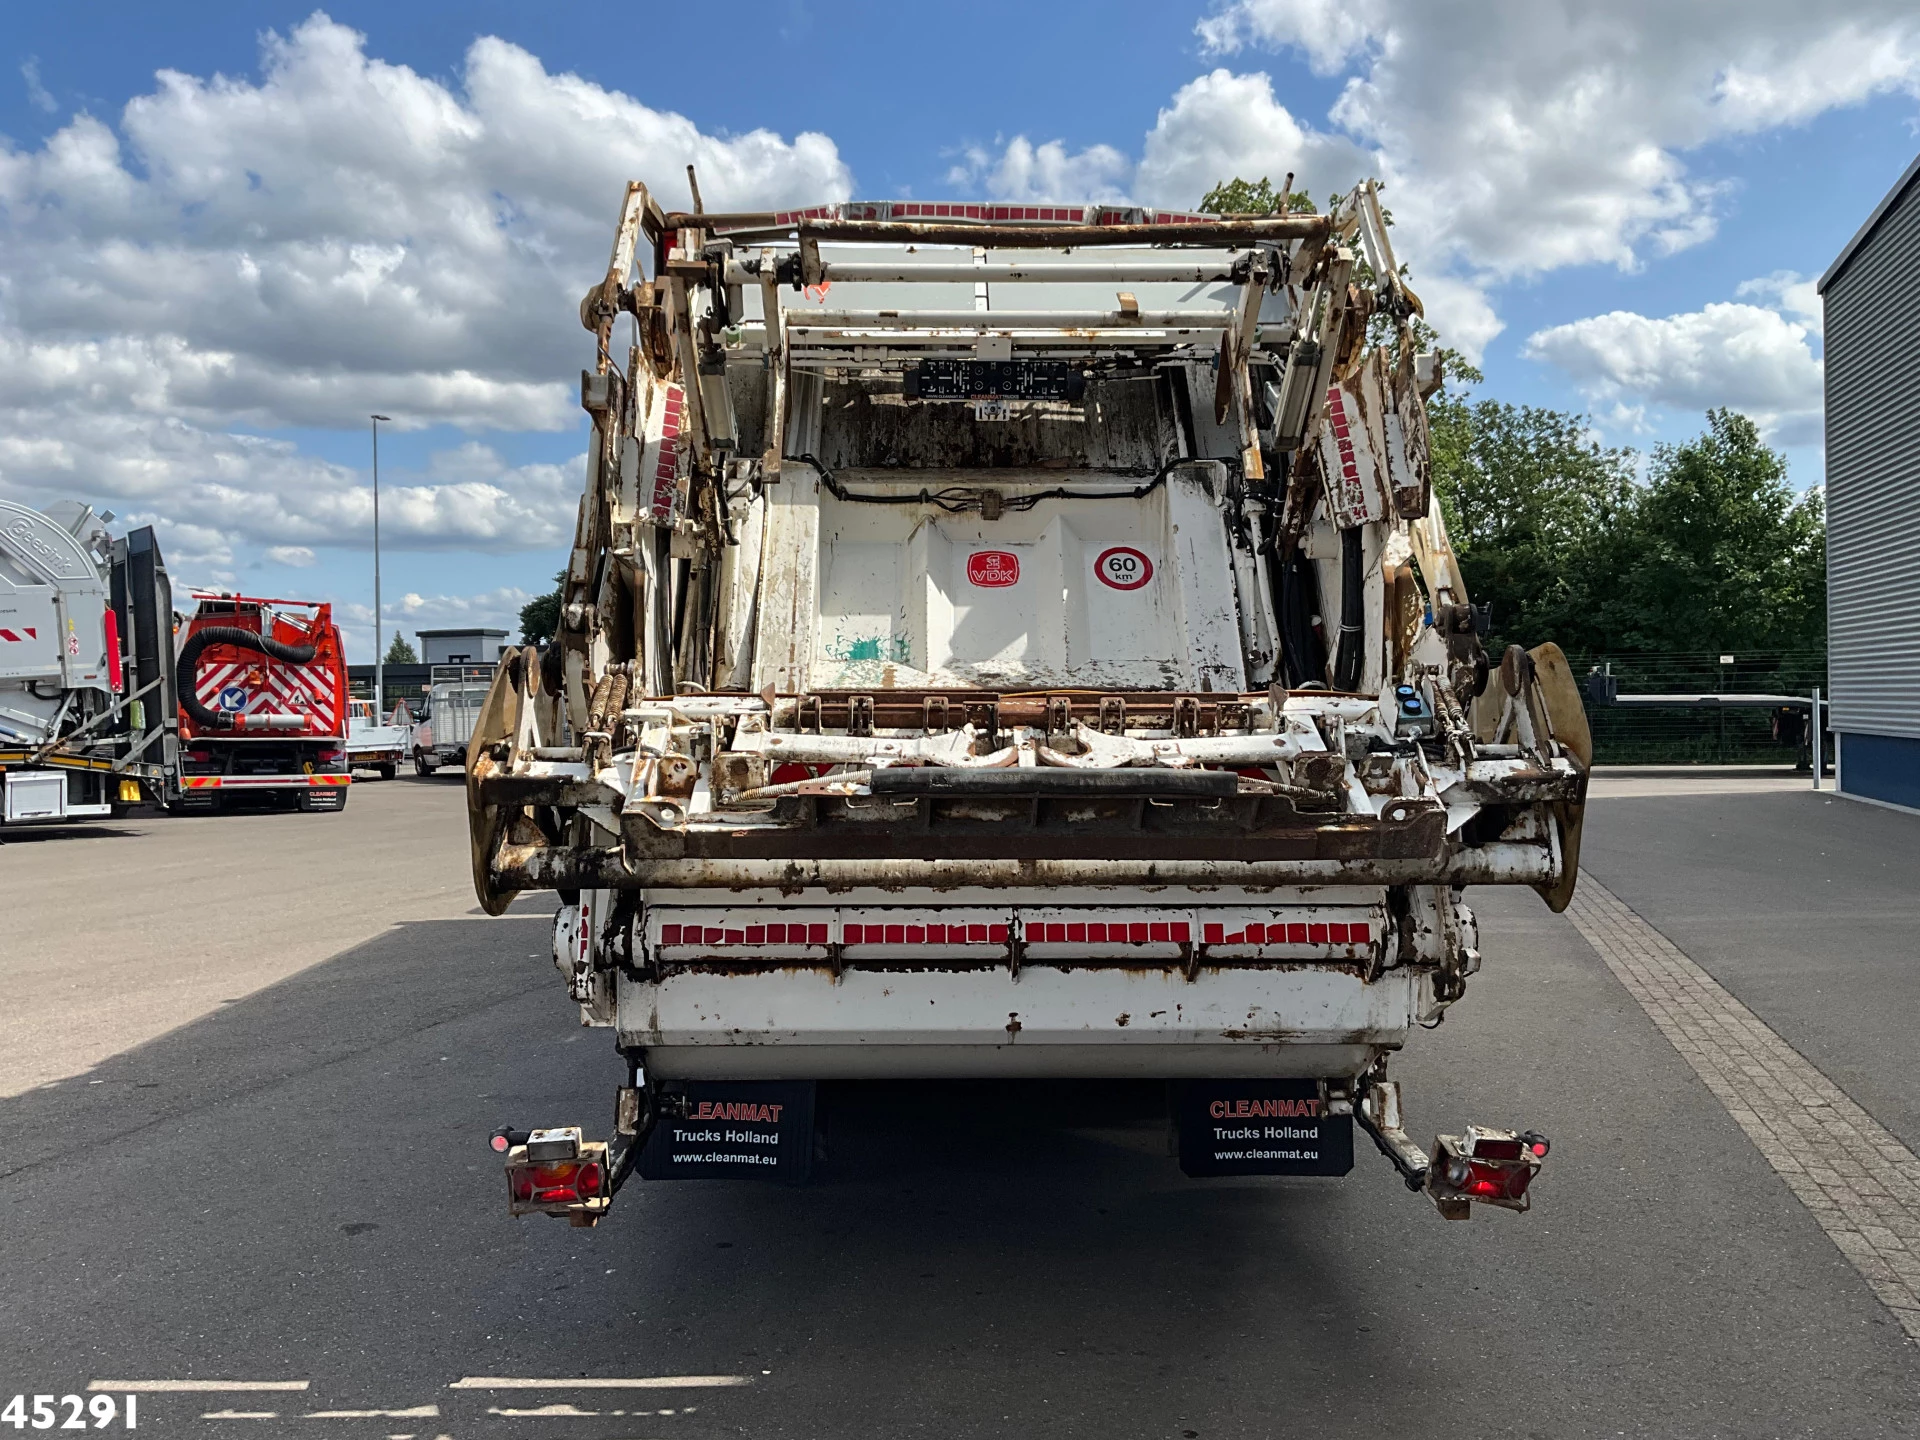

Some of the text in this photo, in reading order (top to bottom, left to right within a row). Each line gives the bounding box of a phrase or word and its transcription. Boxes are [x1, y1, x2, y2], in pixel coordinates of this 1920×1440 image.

[6, 515, 72, 573] Geesink
[1108, 557, 1136, 572] 60
[972, 569, 1014, 582] VDK
[1115, 572, 1133, 581] km
[1210, 1099, 1320, 1118] CLEANMAT
[673, 1129, 779, 1144] Trucks Holland
[1213, 1126, 1318, 1139] Trucks Holland
[672, 1151, 777, 1165] www.cleanmat.eu
[1214, 1148, 1319, 1160] www.cleanmat.eu
